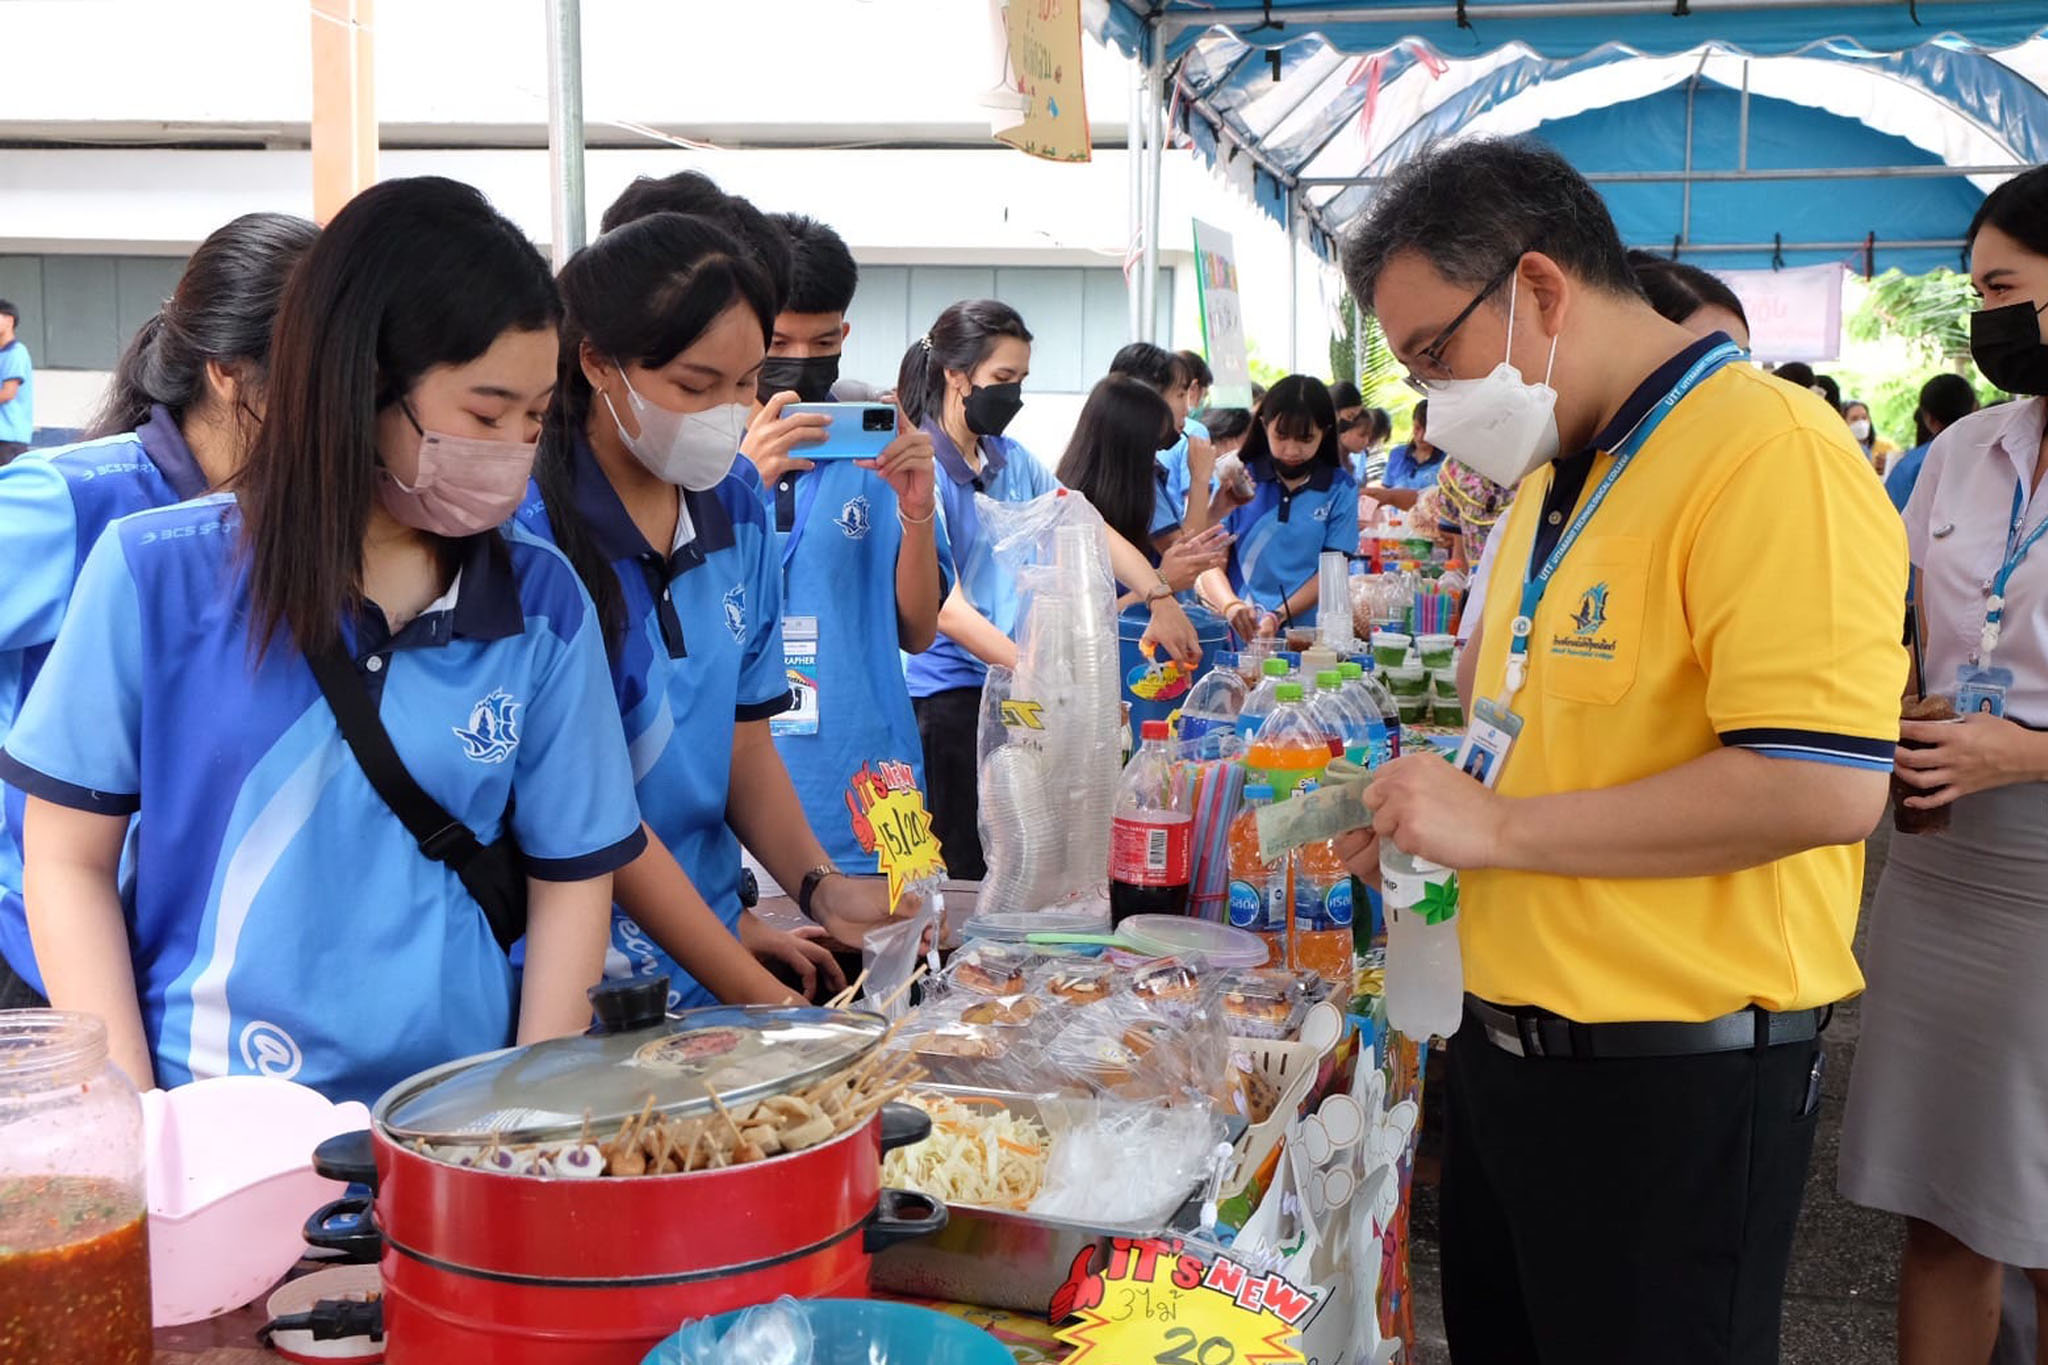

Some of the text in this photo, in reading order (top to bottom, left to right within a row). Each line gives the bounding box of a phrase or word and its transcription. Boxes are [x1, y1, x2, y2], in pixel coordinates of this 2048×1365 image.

[1664, 388, 1682, 407] UTT
[160, 526, 197, 541] BCS
[1539, 562, 1555, 581] UTT
[1203, 1255, 1319, 1325] NEW
[1154, 1326, 1236, 1365] 20
